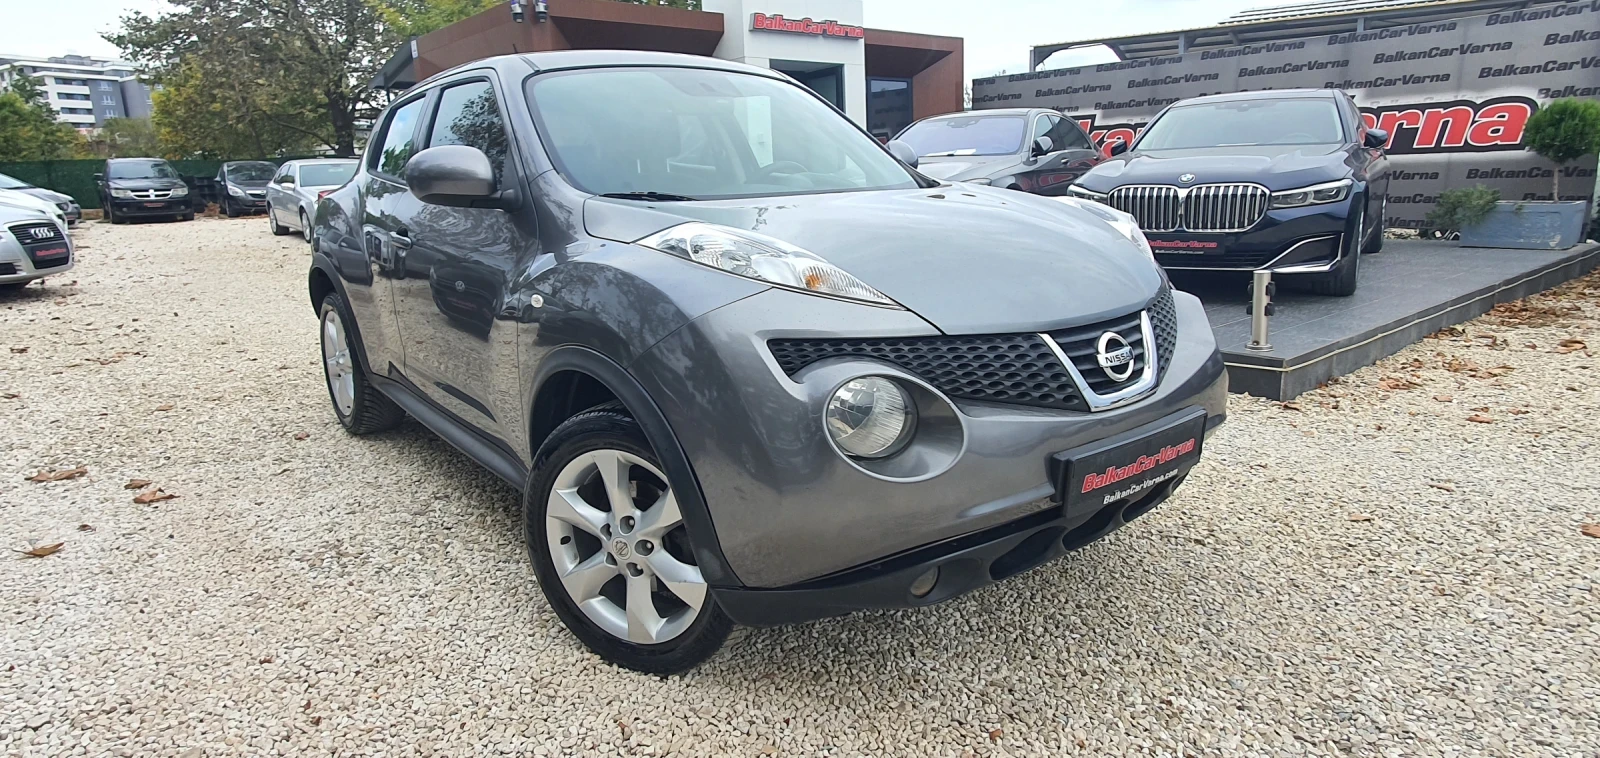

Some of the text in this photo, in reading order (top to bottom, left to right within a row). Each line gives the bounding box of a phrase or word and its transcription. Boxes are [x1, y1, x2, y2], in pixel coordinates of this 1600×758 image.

[754, 14, 863, 37] BalkanCarVarna
[1327, 21, 1457, 46] BalkanCarVarna
[1201, 41, 1305, 60] BalkanCarVarna
[1373, 40, 1513, 64] BalkanCarVarna
[1096, 56, 1183, 73] BalkanCarVarna
[1238, 59, 1349, 78] BalkanCarVarna
[1008, 68, 1081, 83] BalkanCarVarna
[1128, 72, 1219, 89] BalkanCarVarna
[1324, 73, 1451, 90] BalkanCarVarna
[1035, 83, 1112, 98] BalkanCarVarna
[1081, 438, 1196, 493] BalkanCarVarna
[1103, 468, 1178, 504] BalkanCarVarna.com
